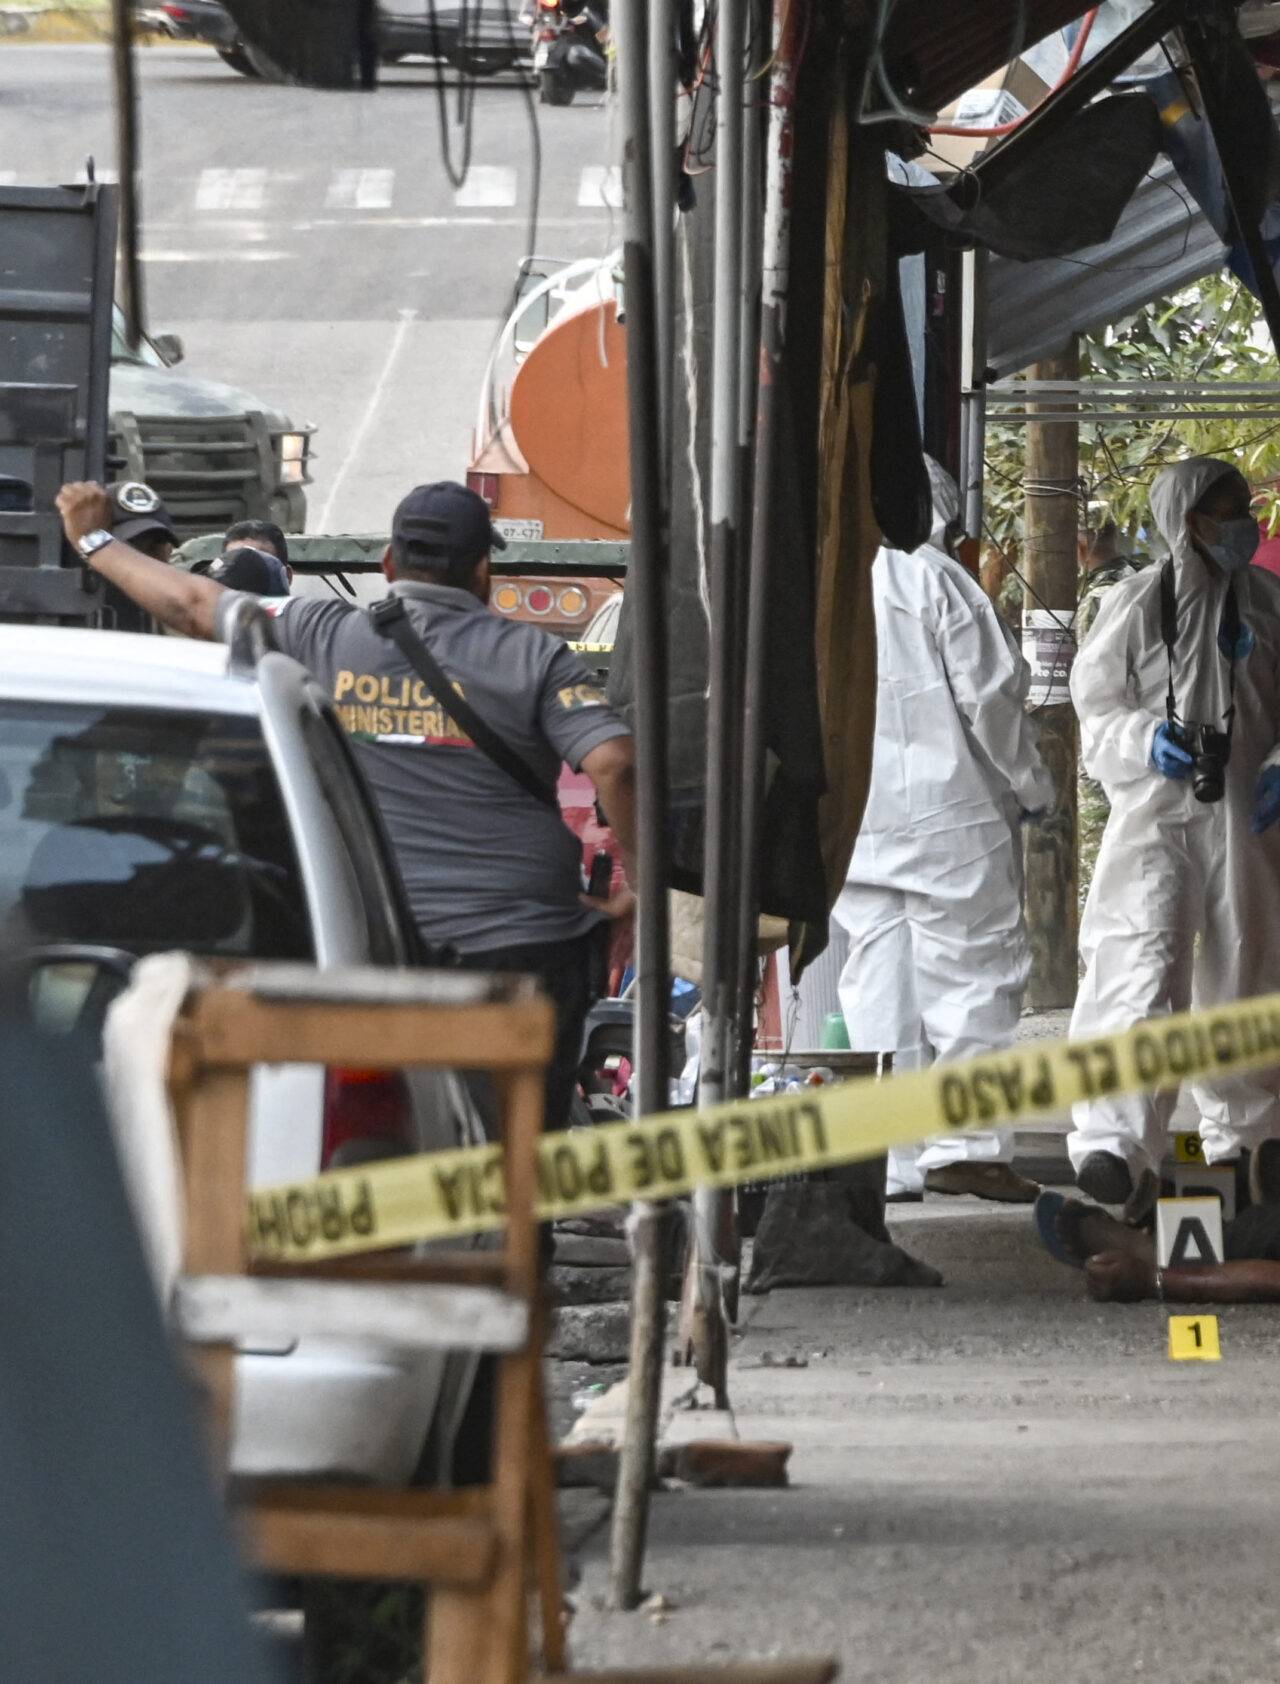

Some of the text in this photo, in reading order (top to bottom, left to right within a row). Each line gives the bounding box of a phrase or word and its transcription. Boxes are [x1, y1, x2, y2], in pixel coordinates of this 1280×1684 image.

[334, 670, 467, 708] POLIC
[333, 703, 470, 739] MINISTERIA
[1067, 1036, 1119, 1097] EL
[939, 1064, 1058, 1129] PASO
[626, 1126, 686, 1187] DE
[697, 1102, 829, 1173] LINEA
[1184, 1135, 1201, 1157] 6
[1168, 1216, 1219, 1268] A
[1187, 1321, 1202, 1348] 1
